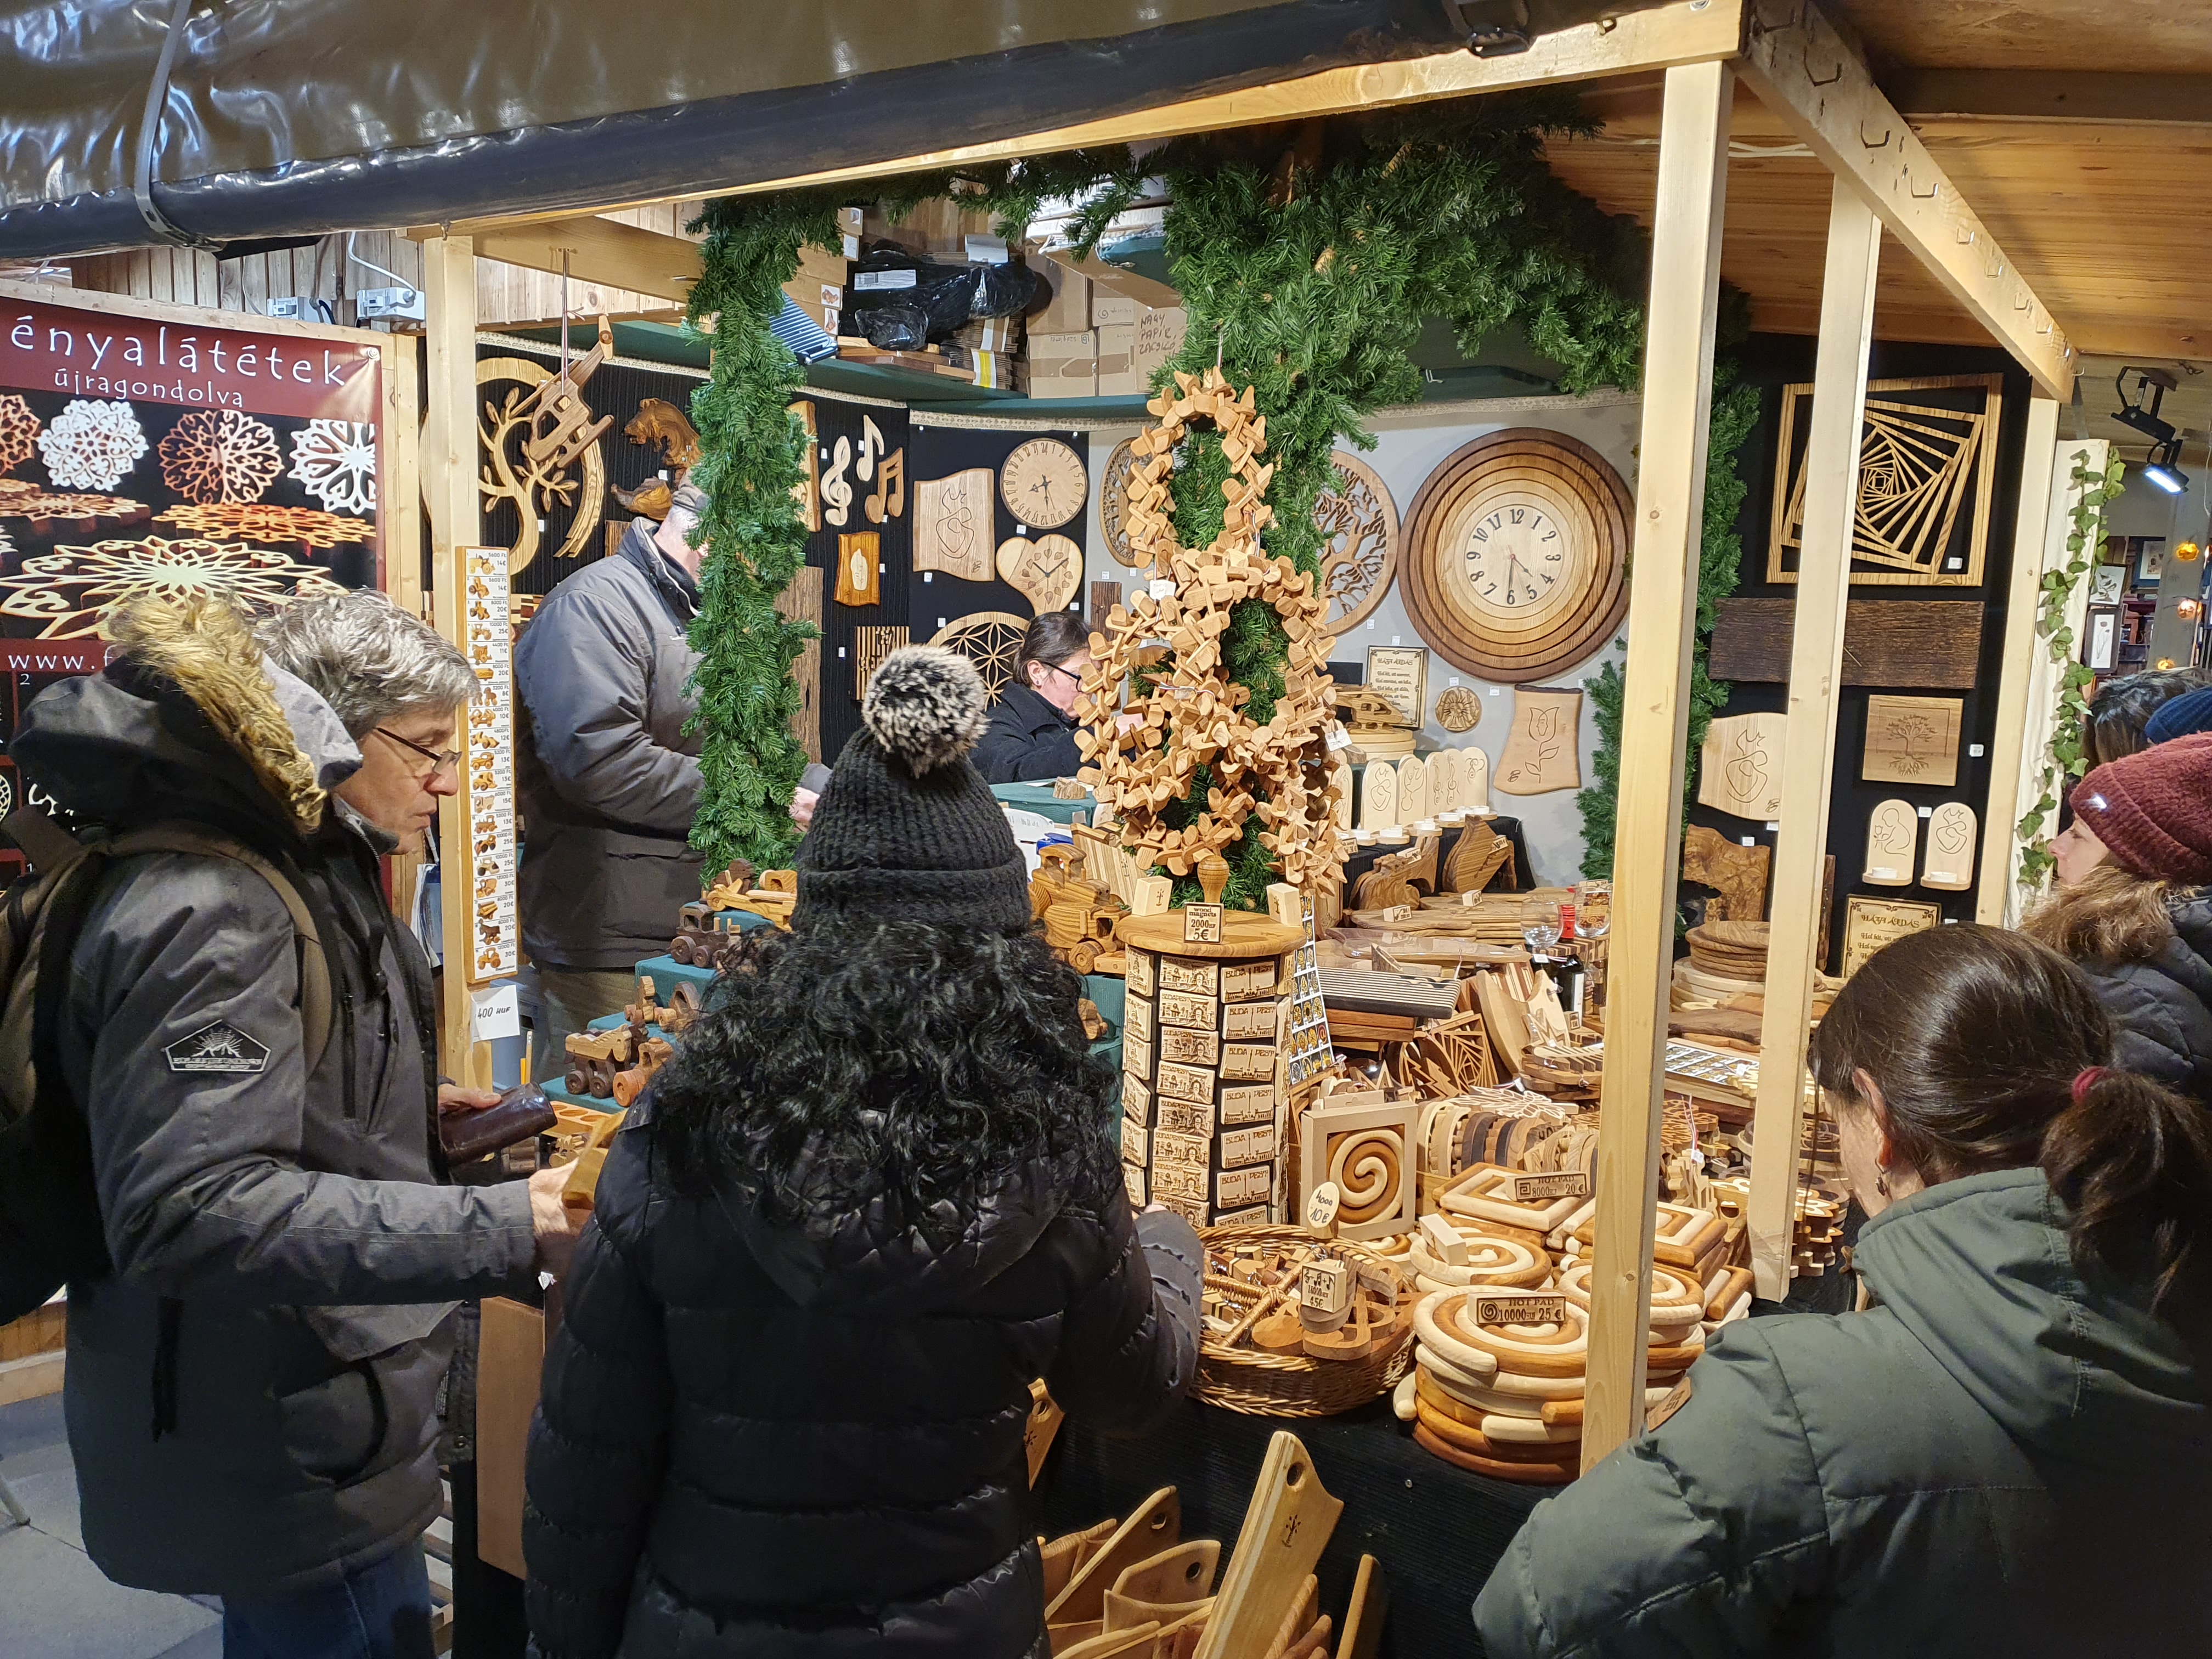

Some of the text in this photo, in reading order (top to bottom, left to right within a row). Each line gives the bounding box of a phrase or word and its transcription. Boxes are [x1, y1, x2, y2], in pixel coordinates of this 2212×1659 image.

[10, 315, 345, 387] ényalátétek
[54, 369, 244, 408] újragondolva
[1486, 512, 1502, 531] 11
[1509, 509, 1525, 524] 12
[1531, 516, 1543, 530] 1
[1472, 527, 1488, 543] 10
[1541, 531, 1556, 542] 2
[1466, 551, 1481, 560] 9
[1470, 571, 1485, 582] 8
[1540, 573, 1555, 584] 4
[1483, 582, 1498, 595] 7
[1526, 584, 1537, 600] 5
[1506, 589, 1515, 605] 6
[1193, 928, 1209, 940] 5€
[1225, 968, 1246, 978] BUDA
[478, 1007, 511, 1019] 400 HUF
[1226, 1092, 1246, 1100] BUDA
[1221, 1170, 1268, 1185] BUDA PEST
[1565, 1183, 1576, 1194] 20
[1316, 1189, 1333, 1206] 4000
[1538, 1307, 1551, 1321] 25
[1554, 1309, 1562, 1320] €
